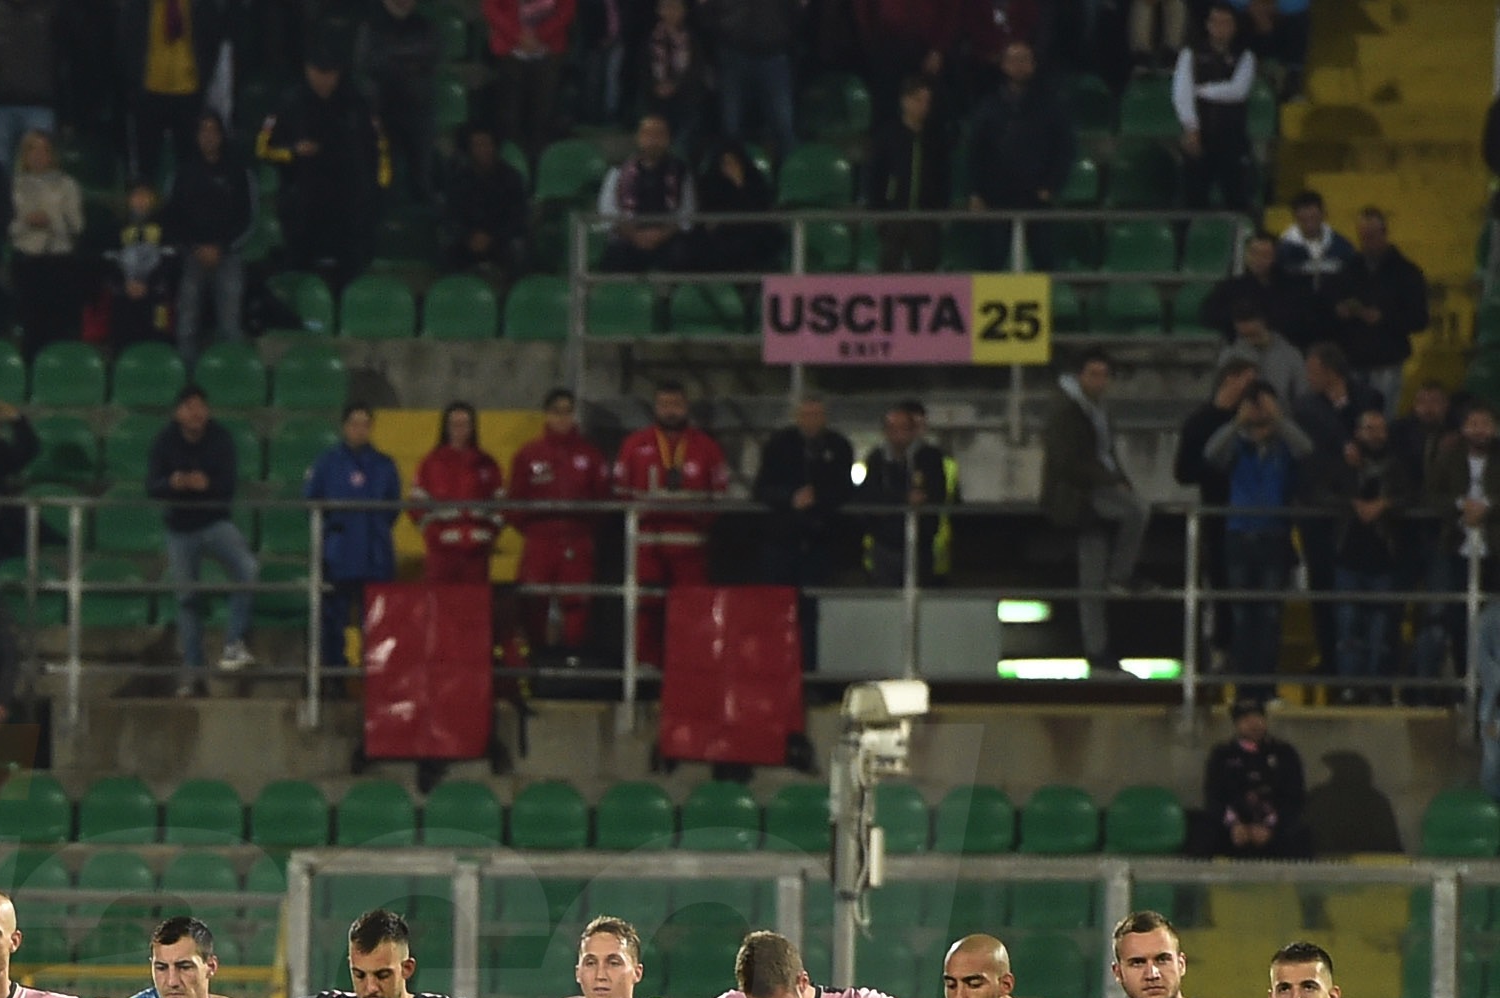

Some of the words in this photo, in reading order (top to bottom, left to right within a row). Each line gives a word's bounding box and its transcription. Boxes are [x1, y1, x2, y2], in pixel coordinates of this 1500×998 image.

[769, 294, 966, 335] USCITA
[978, 301, 1041, 342] 25
[838, 341, 891, 357] EXIT
